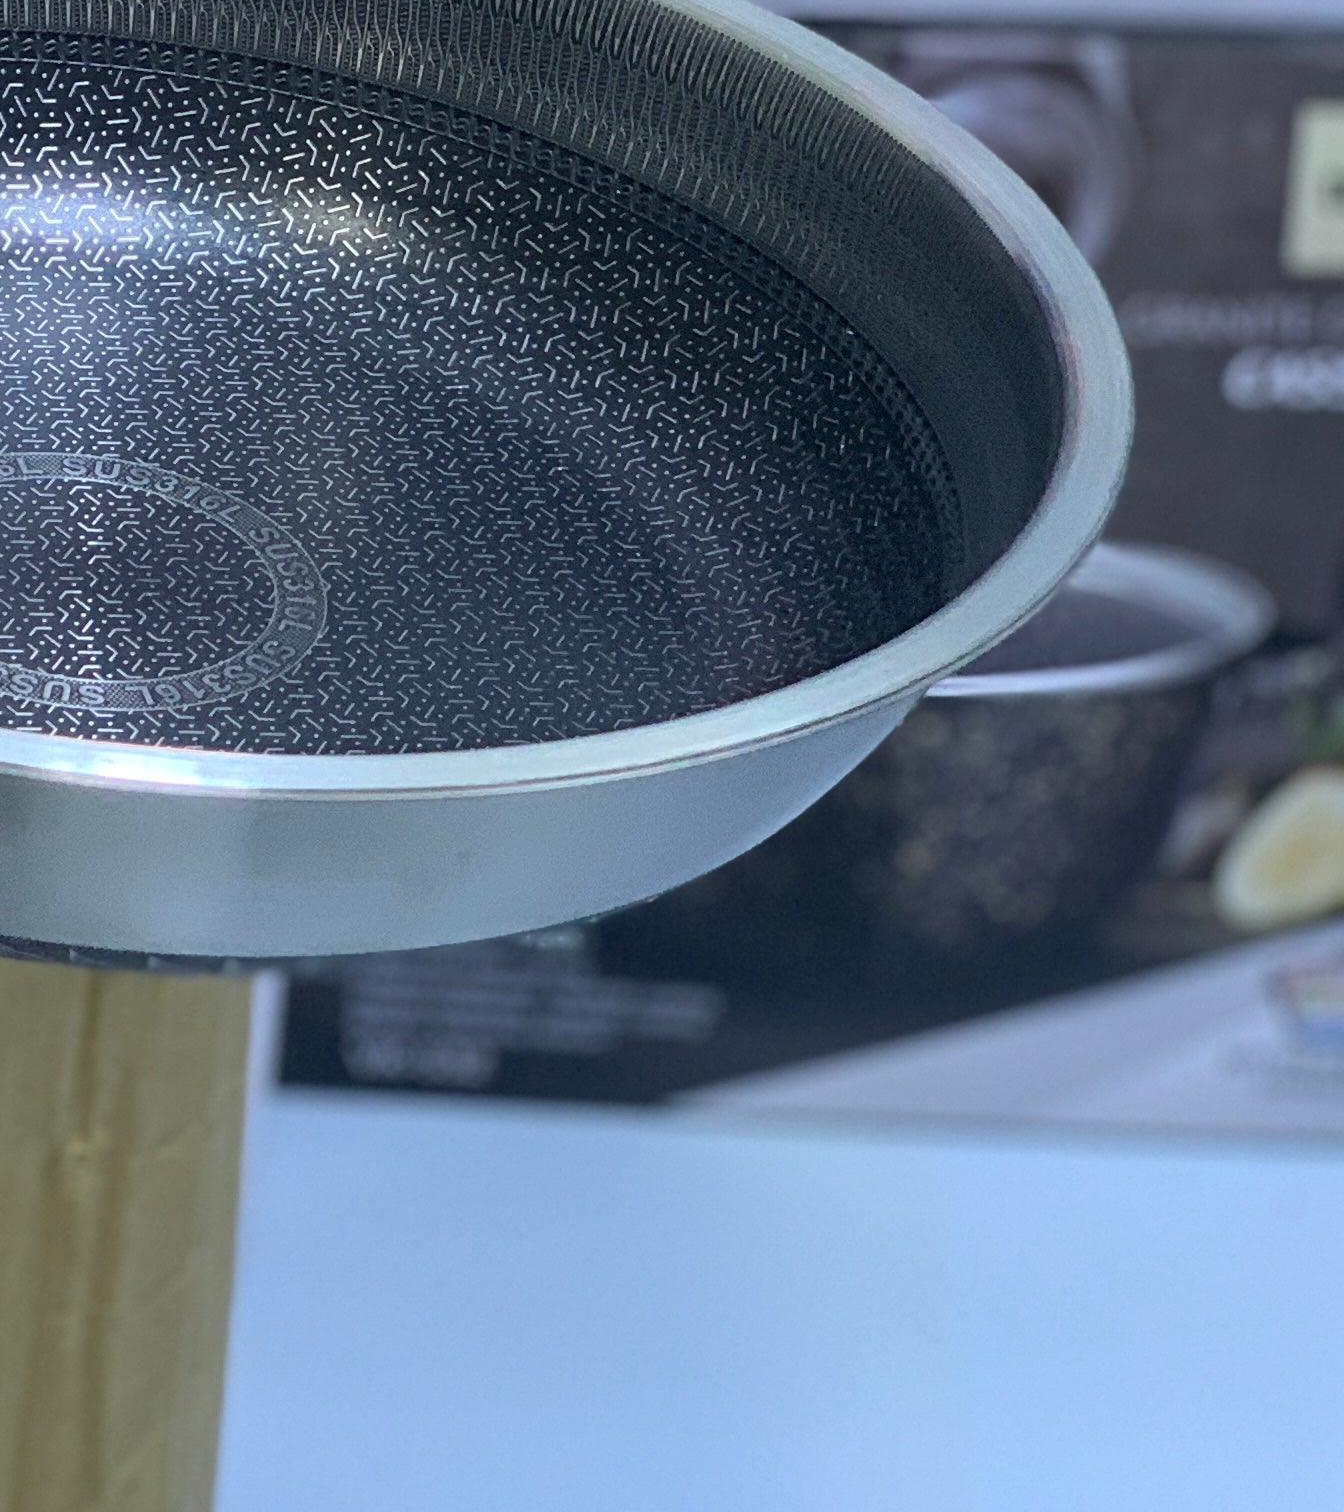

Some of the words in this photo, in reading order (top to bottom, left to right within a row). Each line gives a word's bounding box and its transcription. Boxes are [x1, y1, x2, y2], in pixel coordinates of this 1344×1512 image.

[61, 460, 241, 524] SUS316L
[247, 525, 315, 634] SUS316L
[141, 638, 297, 707] SUS316L
